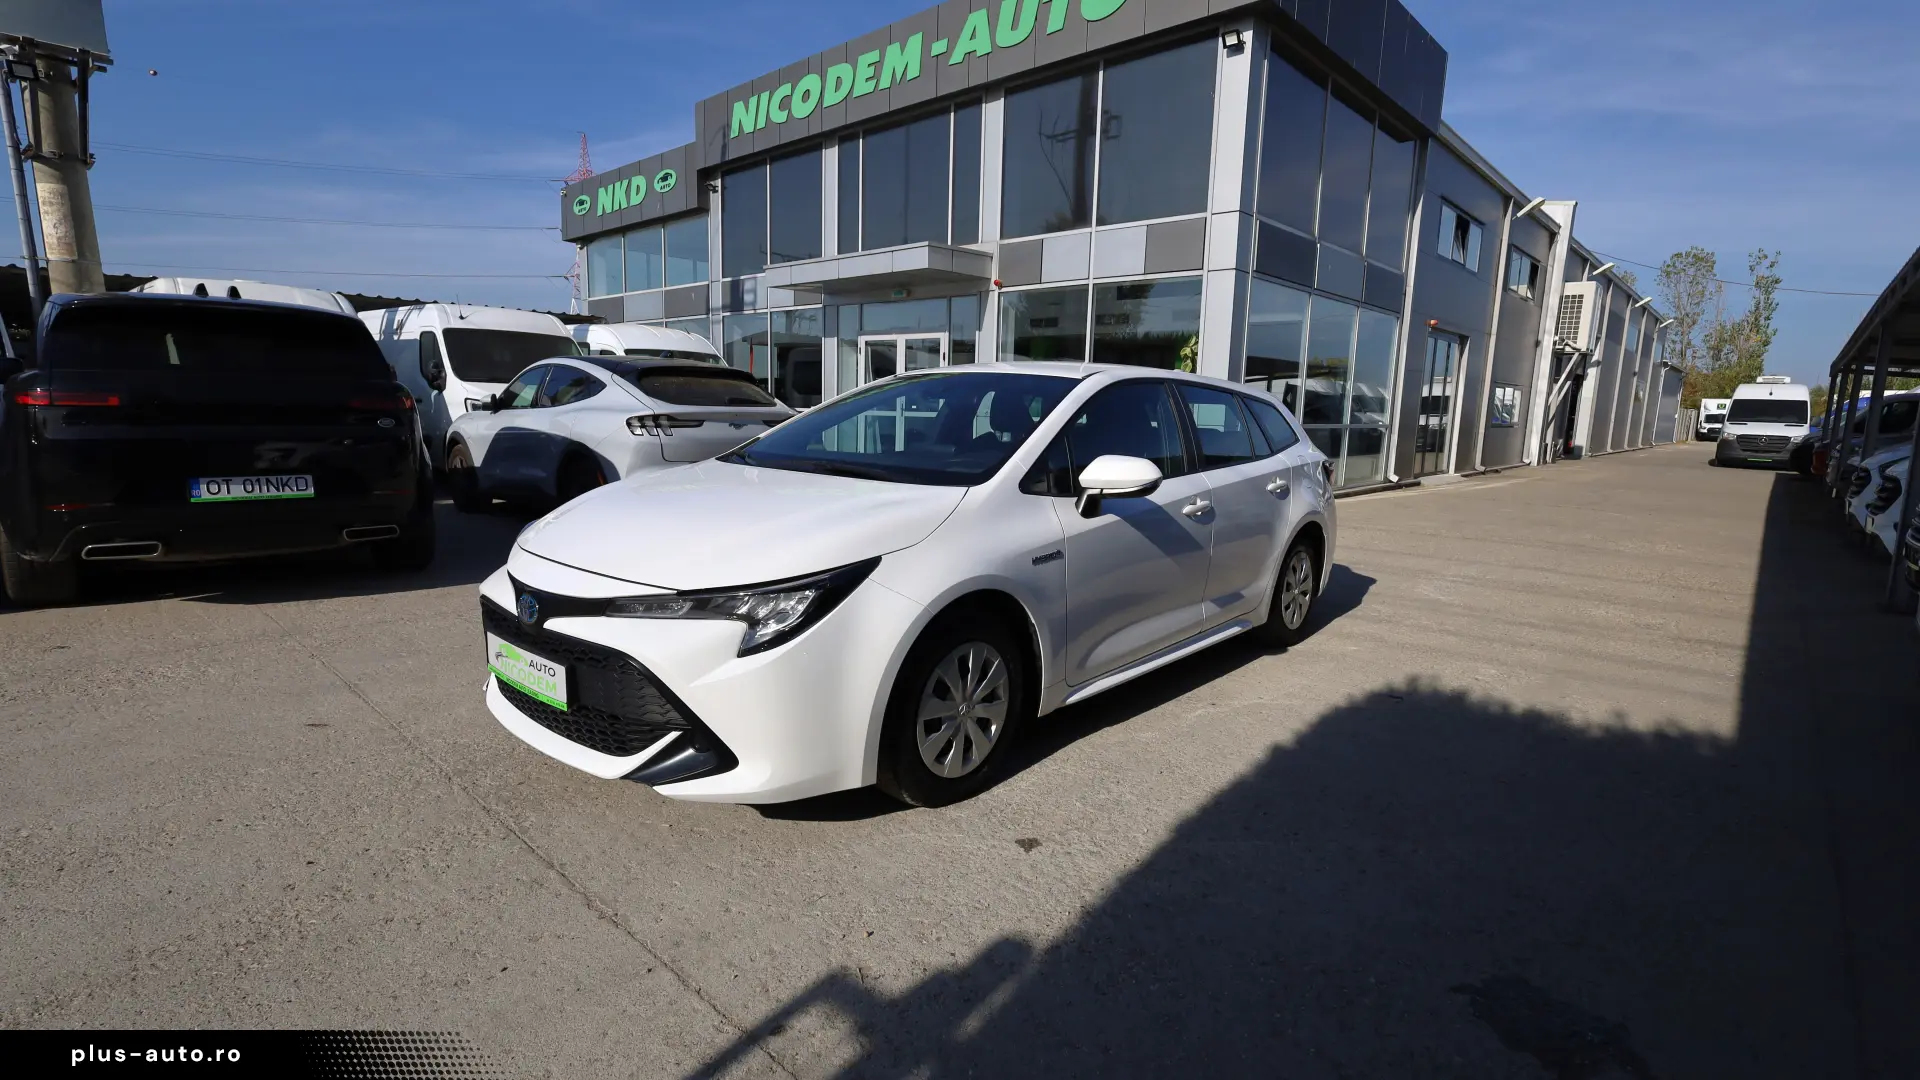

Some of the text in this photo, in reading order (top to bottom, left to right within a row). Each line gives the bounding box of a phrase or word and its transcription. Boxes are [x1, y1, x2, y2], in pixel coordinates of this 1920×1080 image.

[597, 175, 647, 217] NKD
[206, 479, 233, 496] OT
[500, 658, 557, 697] NICODEM
[529, 659, 556, 677] AUTO
